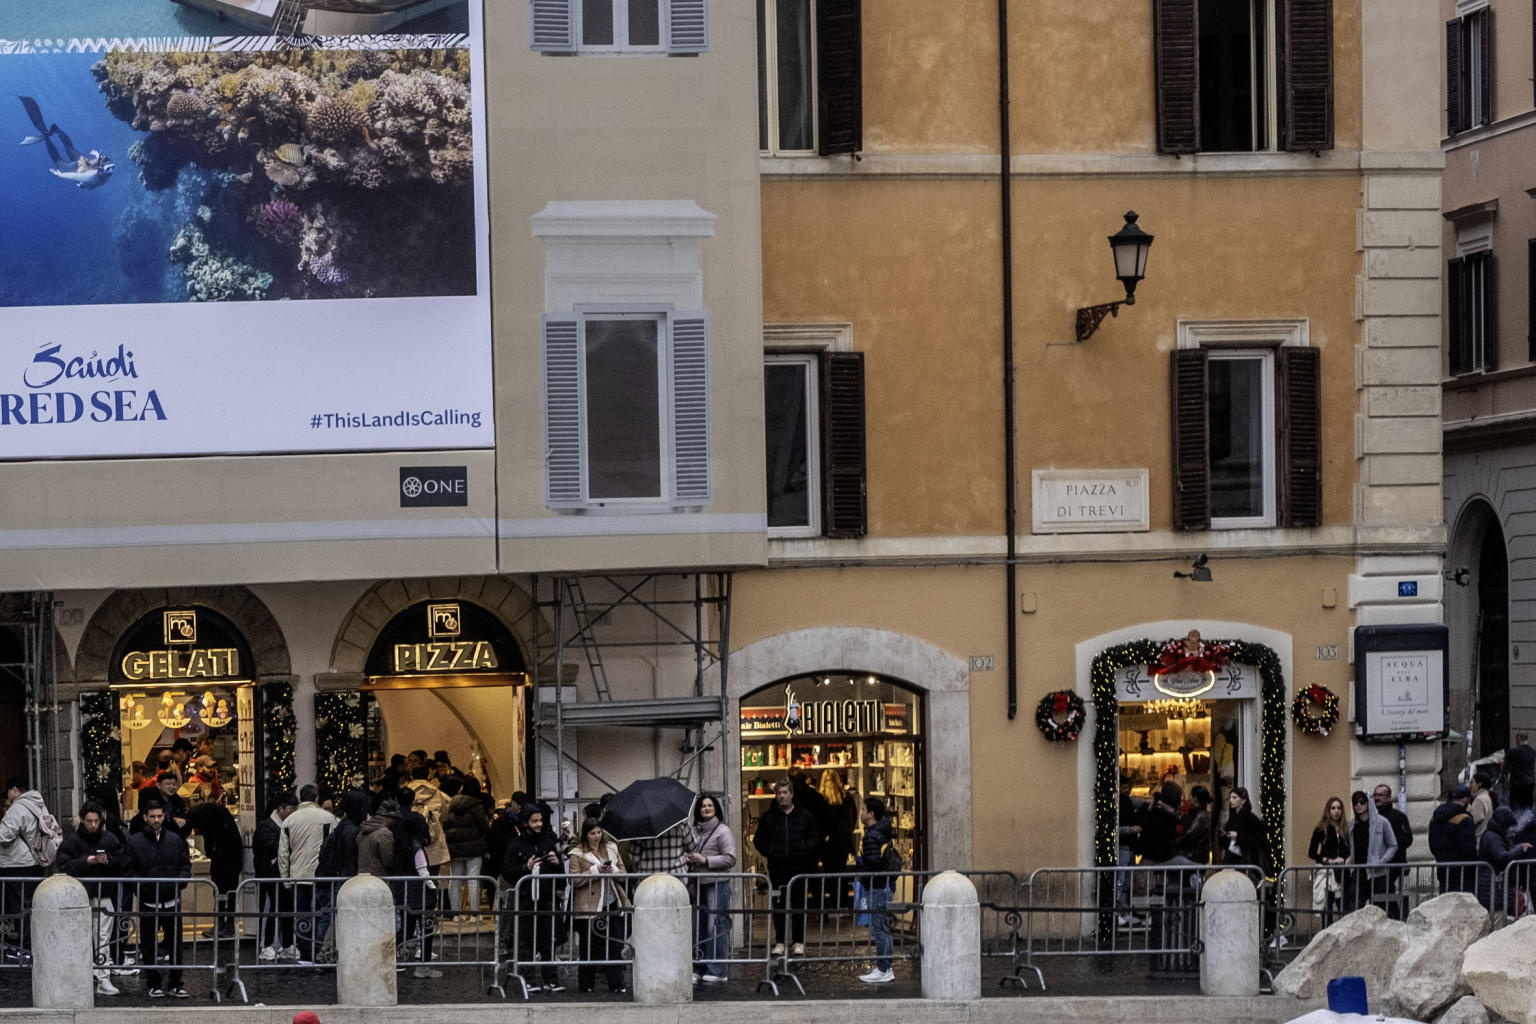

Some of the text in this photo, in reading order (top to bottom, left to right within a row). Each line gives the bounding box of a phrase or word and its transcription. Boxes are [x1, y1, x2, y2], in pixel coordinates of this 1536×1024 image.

[23, 342, 139, 389] Saudi
[0, 388, 168, 426] RED SEA
[310, 408, 482, 429] #ThisLandIsCalling
[423, 479, 465, 494] ONE
[1066, 484, 1117, 497] PIAZZA
[1057, 505, 1125, 518] DI TREVI
[121, 648, 240, 680] GELATI
[394, 641, 499, 672] PIZZA
[1386, 660, 1424, 669] ACQUA
[754, 720, 781, 730] Bialetti
